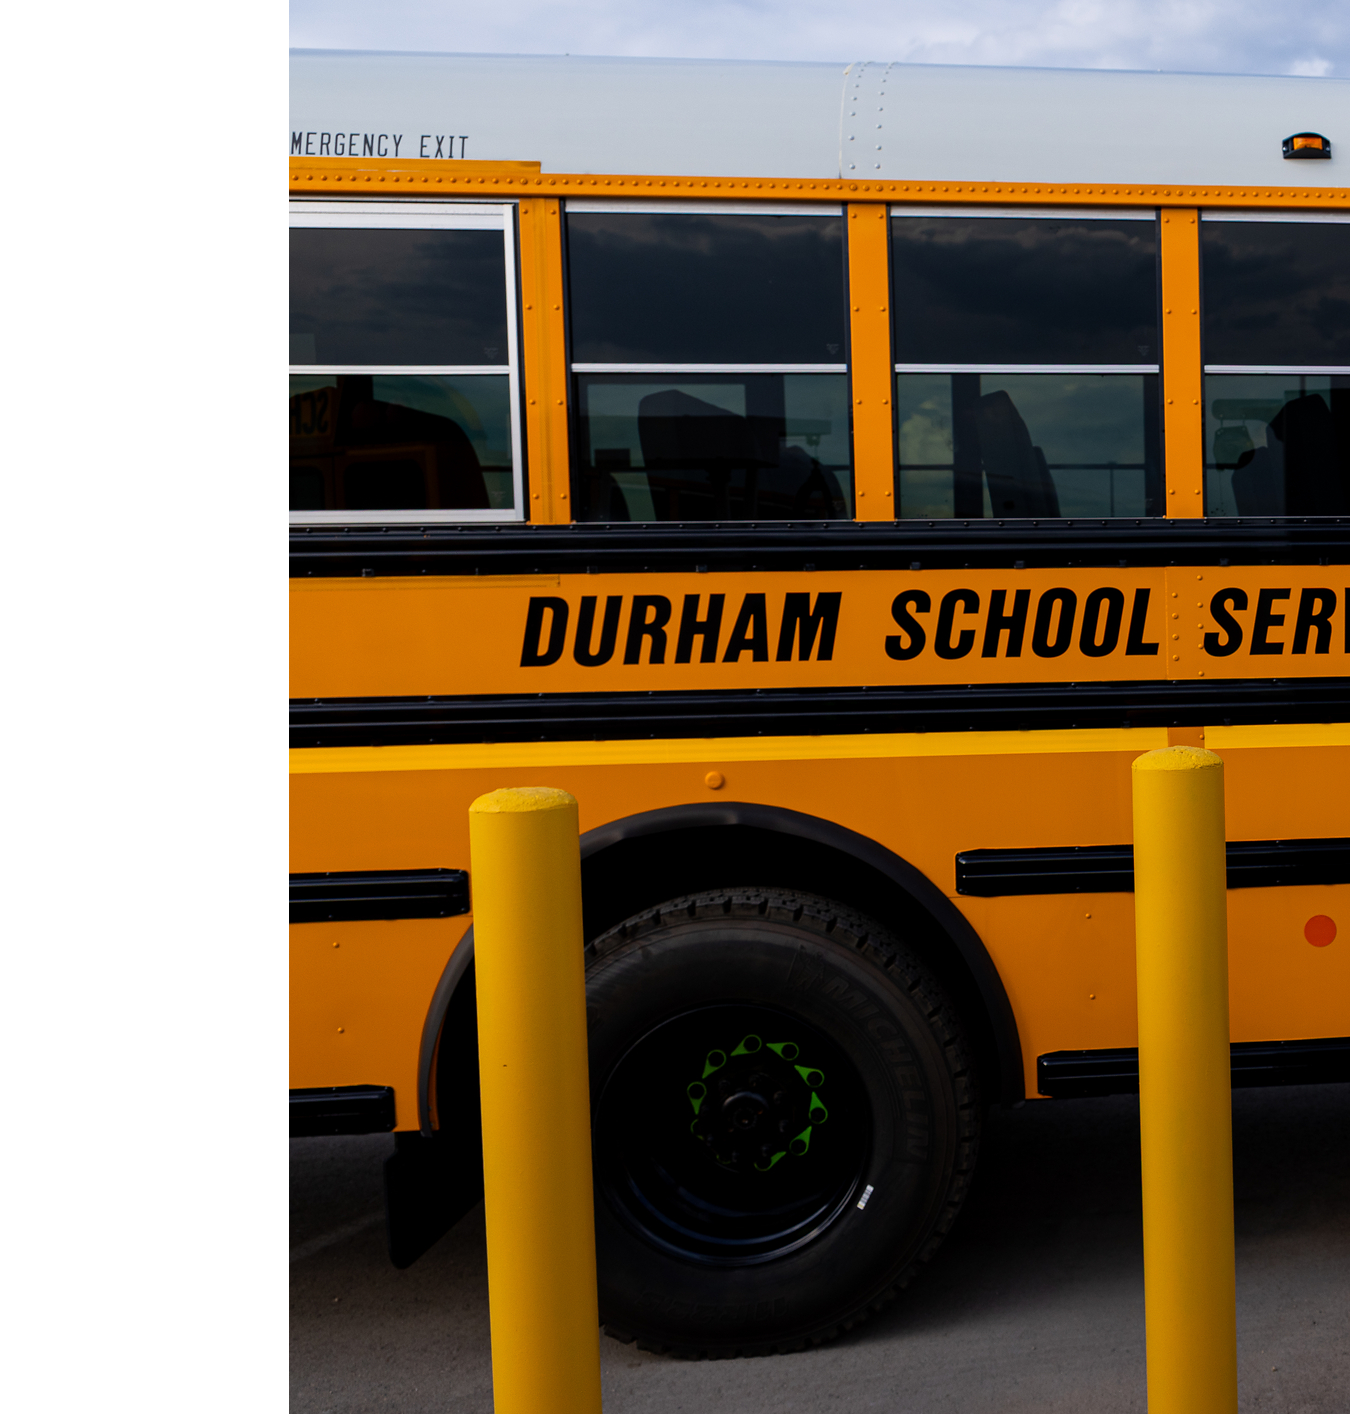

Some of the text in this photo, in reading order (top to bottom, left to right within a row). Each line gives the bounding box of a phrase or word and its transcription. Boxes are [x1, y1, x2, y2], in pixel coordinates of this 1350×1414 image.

[290, 131, 469, 159] MERGENCY EXIT
[519, 591, 843, 668] DURHAM
[884, 587, 1160, 661] SCHOOL
